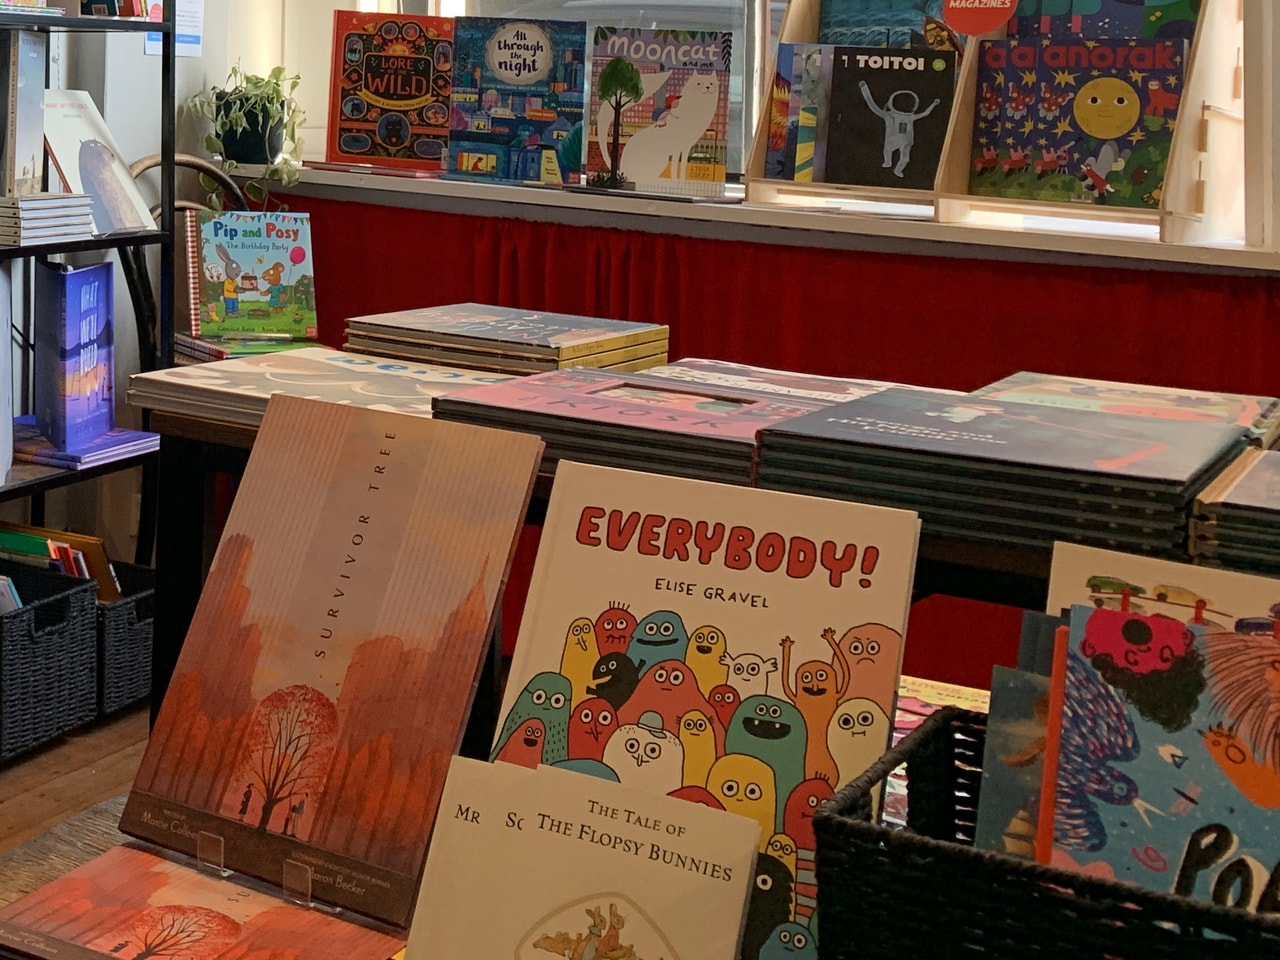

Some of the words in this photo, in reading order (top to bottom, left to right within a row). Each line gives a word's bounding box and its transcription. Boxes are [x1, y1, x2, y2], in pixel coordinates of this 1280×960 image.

[513, 30, 528, 41] All
[497, 40, 544, 57] through
[510, 51, 522, 61] the
[607, 36, 720, 65] mooncat
[1043, 43, 1176, 70] anorak
[381, 57, 414, 71] LORE
[498, 58, 539, 77] night
[856, 54, 926, 71] TOITOI
[367, 72, 428, 96] WILD
[213, 221, 238, 240] Pip
[242, 228, 261, 238] and
[266, 222, 299, 242] Posy
[241, 243, 270, 253] Birthday
[272, 243, 289, 253] Party
[81, 281, 99, 310] WHAT
[554, 396, 730, 432] KIOSK
[368, 431, 397, 492] TREE
[576, 506, 879, 588] EVERYBODY!
[314, 514, 371, 660] SURVIVOR
[655, 578, 697, 596] ELISE
[704, 587, 769, 608] GRAVEL
[141, 811, 169, 830] Marcie
[588, 799, 619, 820] THE
[624, 809, 660, 831] TALE
[537, 813, 572, 836] THE
[577, 824, 645, 857] FLOPSY
[648, 844, 733, 882] BUNNIES
[335, 875, 366, 896] Becker
